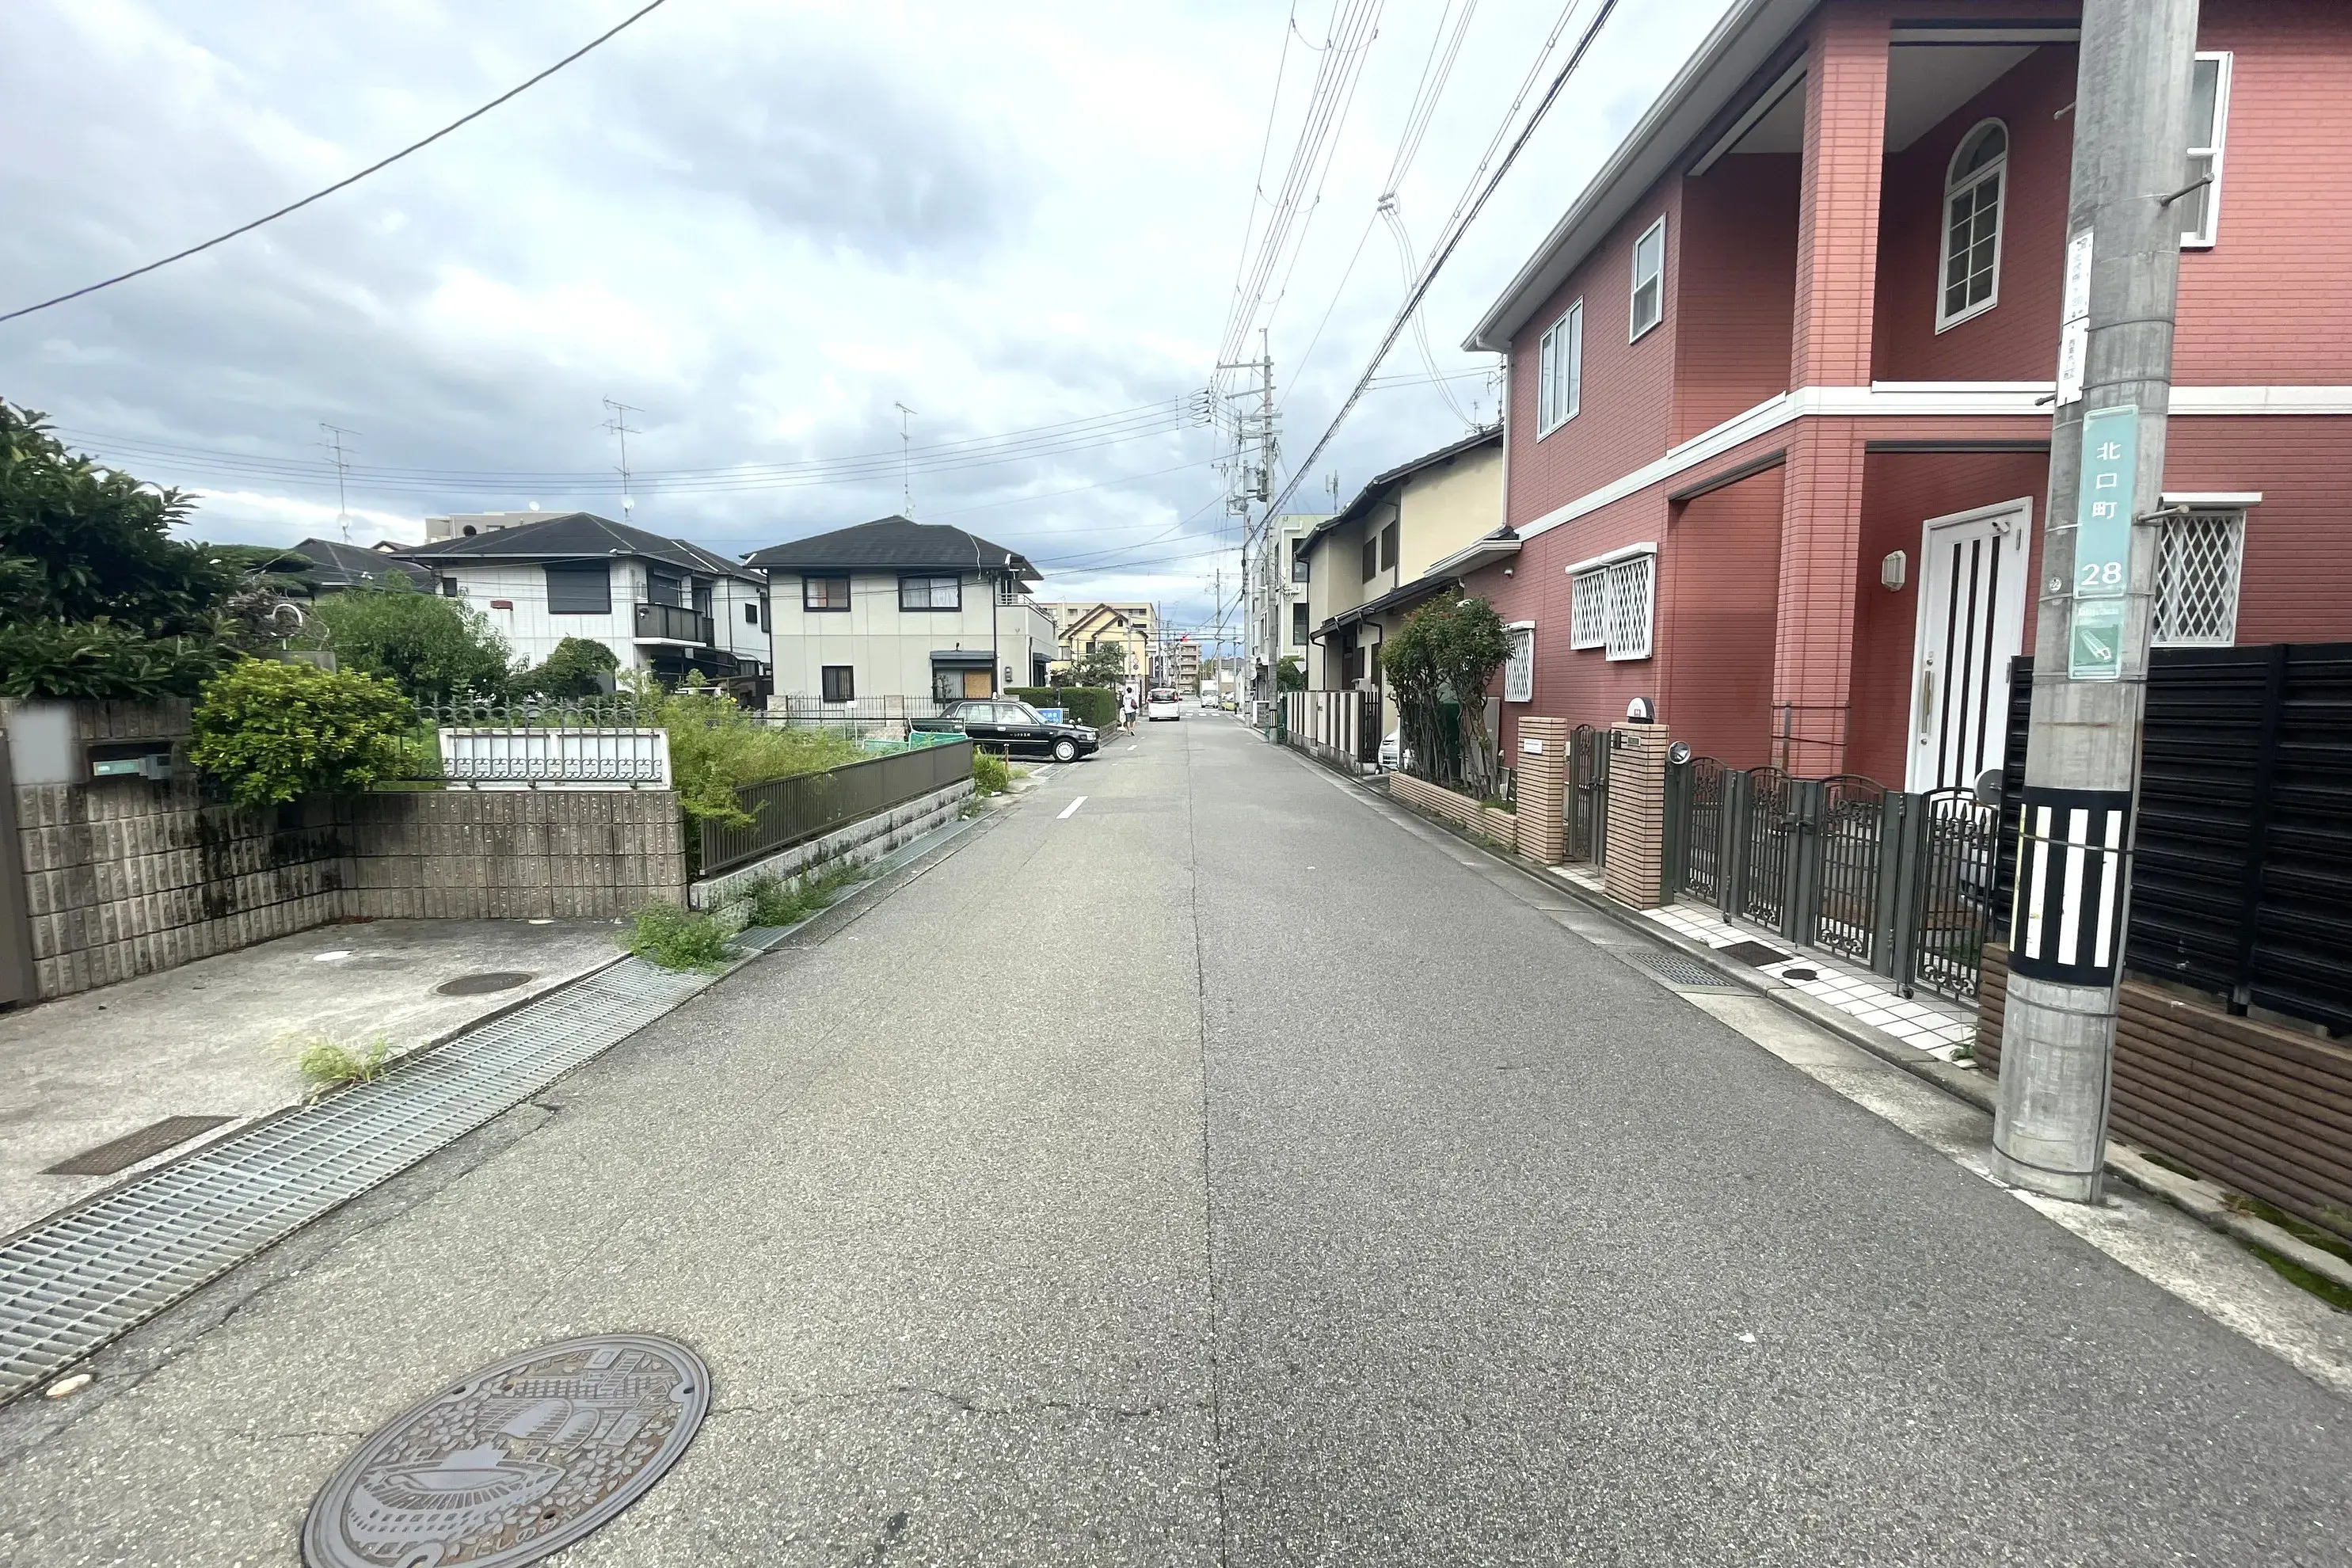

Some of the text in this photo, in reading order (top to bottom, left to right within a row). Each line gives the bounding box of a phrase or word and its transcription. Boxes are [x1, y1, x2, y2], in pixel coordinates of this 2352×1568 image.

[2091, 441, 2122, 519] 北口町
[2080, 561, 2122, 586] 28
